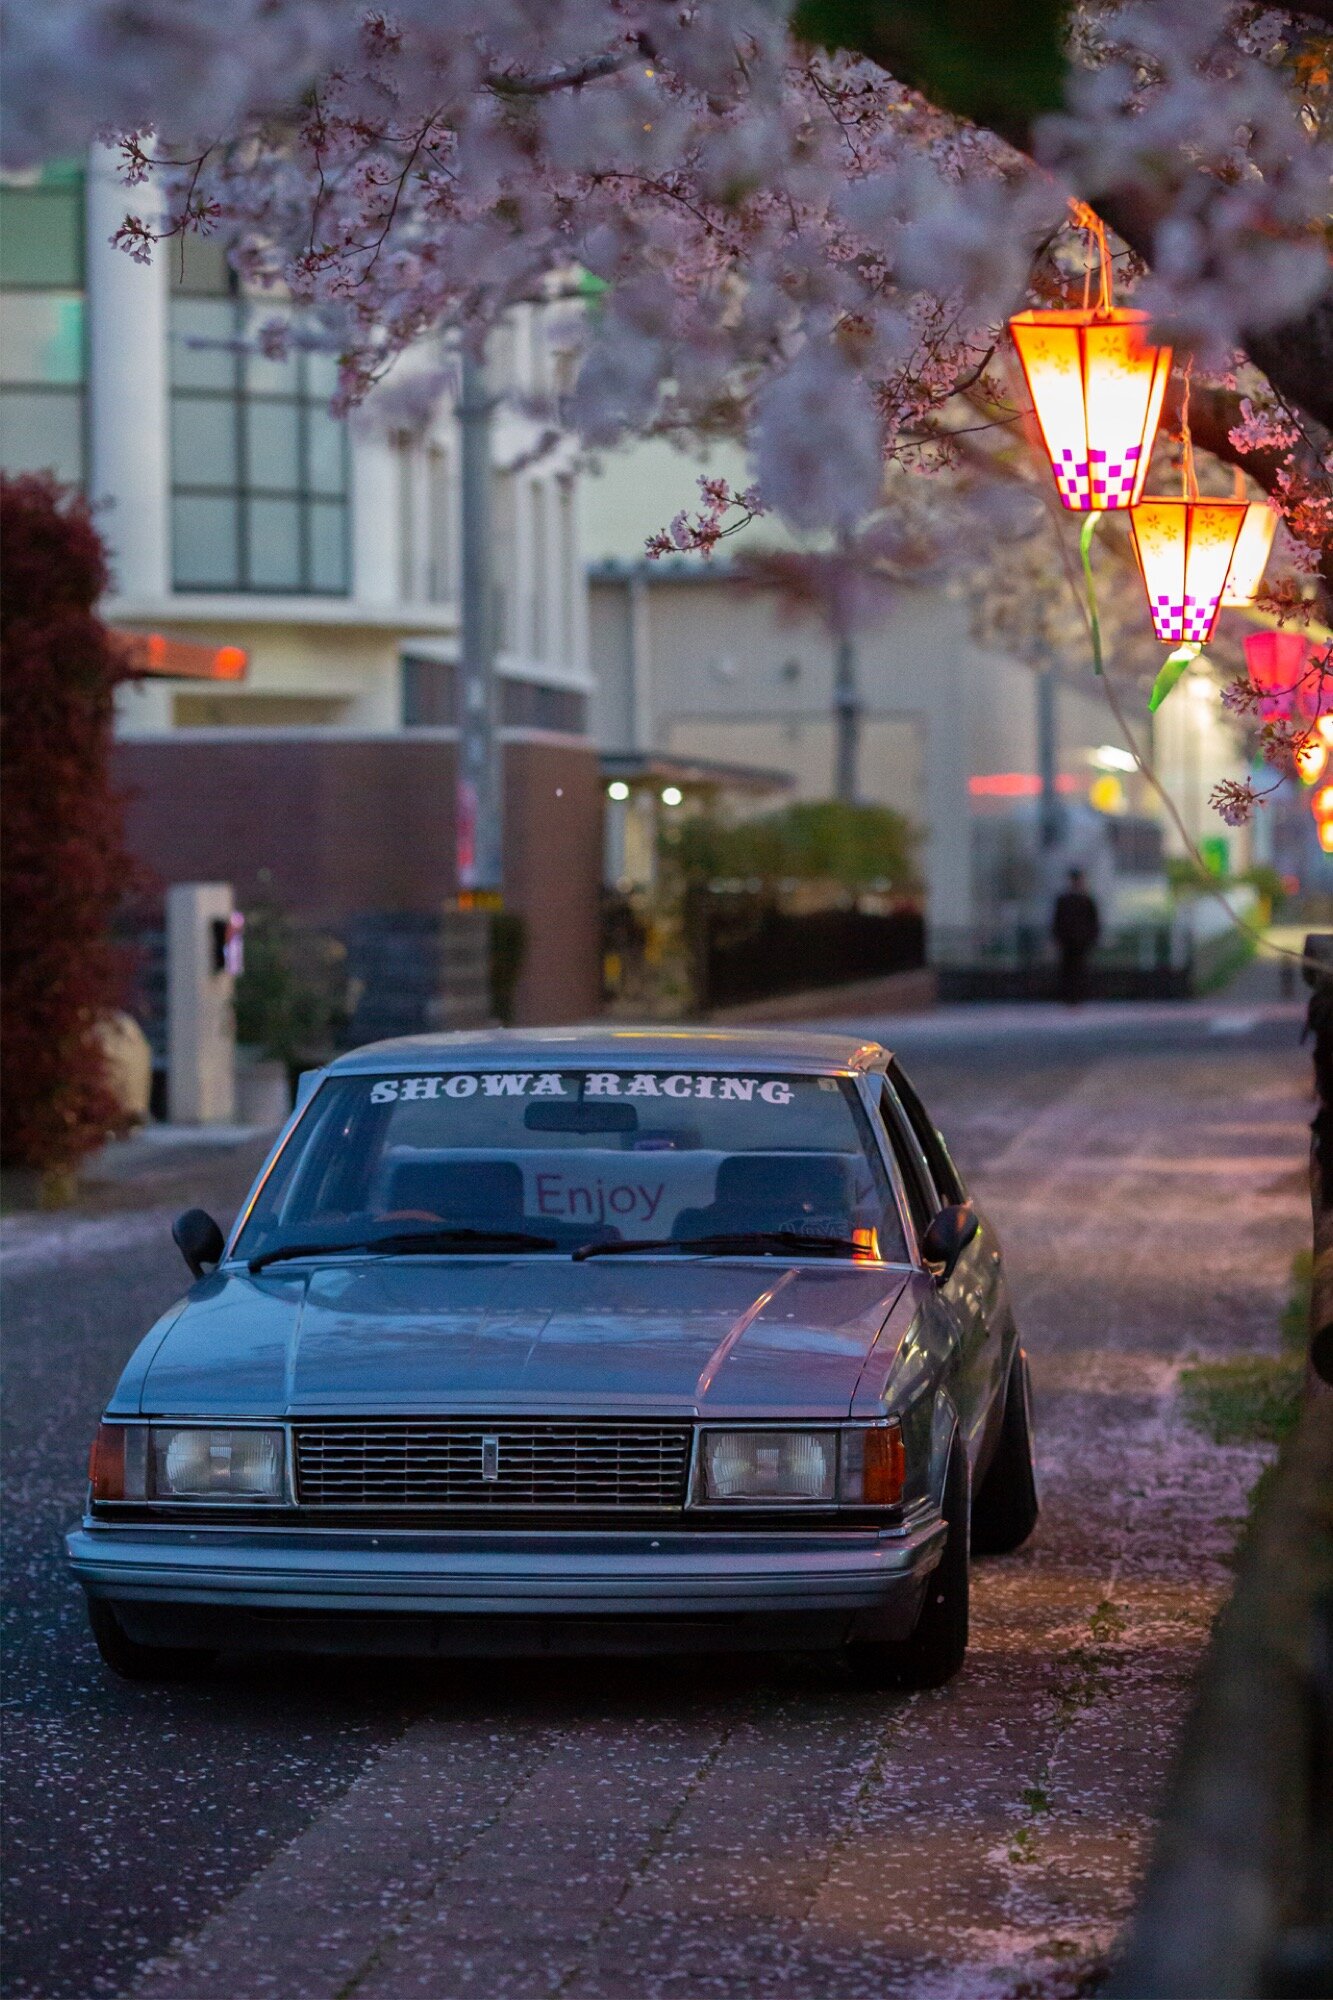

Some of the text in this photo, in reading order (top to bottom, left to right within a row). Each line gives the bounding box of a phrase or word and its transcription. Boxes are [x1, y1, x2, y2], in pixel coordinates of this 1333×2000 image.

[371, 1074, 795, 1104] SHOWA RACING
[536, 1173, 665, 1222] Enjoy
